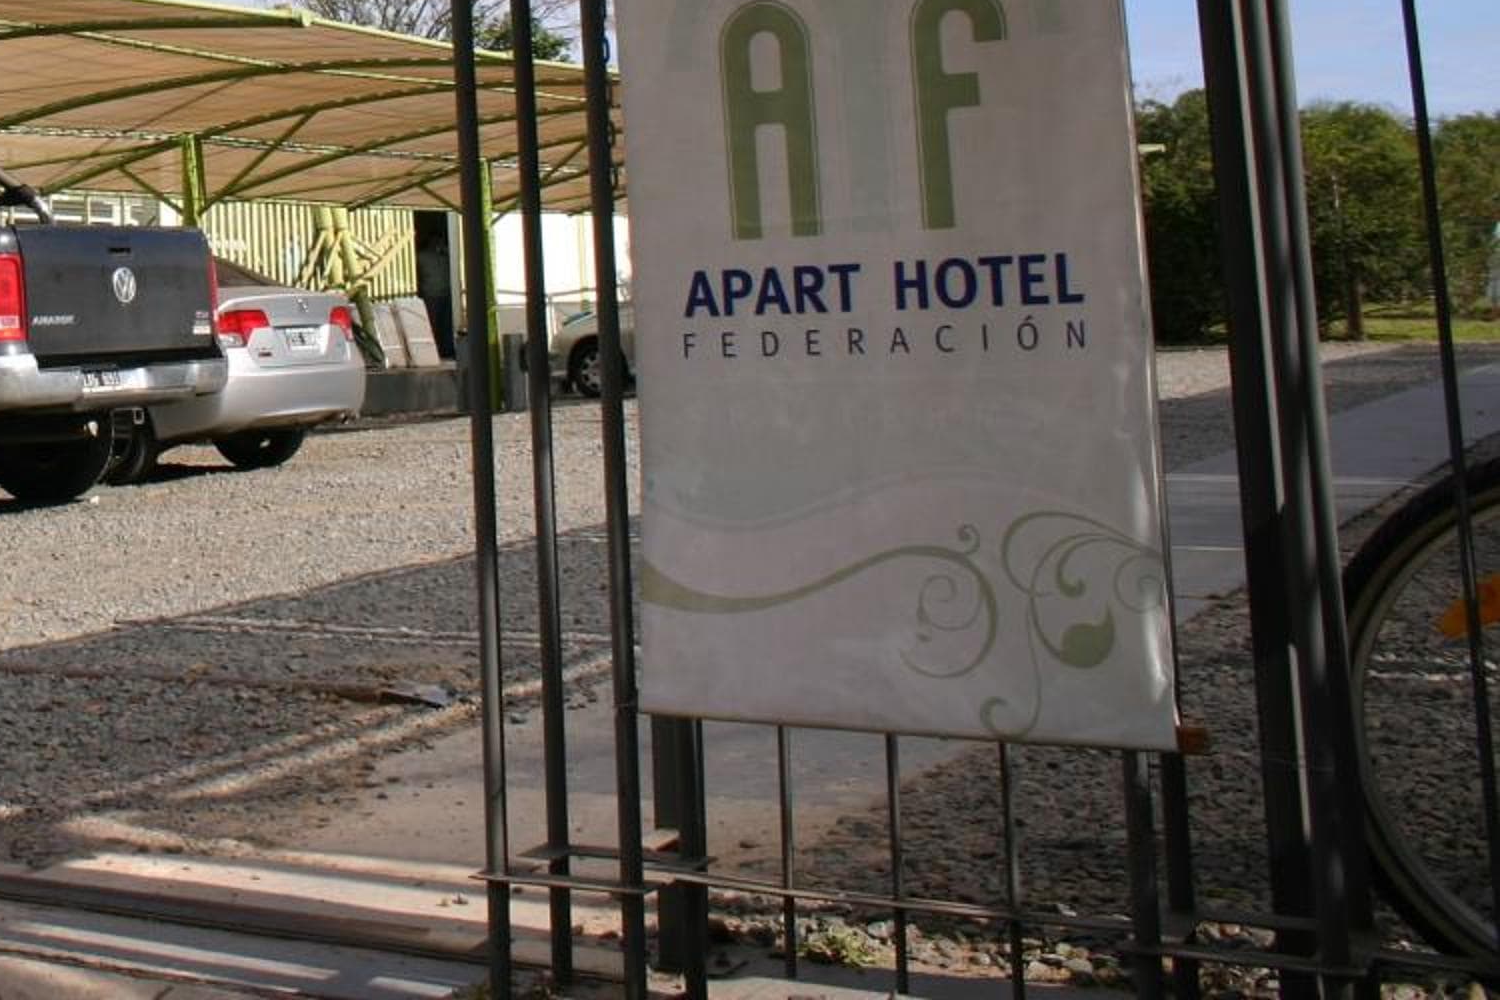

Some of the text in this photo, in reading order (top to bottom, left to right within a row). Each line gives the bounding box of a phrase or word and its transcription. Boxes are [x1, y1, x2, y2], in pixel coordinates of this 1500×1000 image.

[684, 252, 1086, 317] APART HOTEL
[683, 316, 1086, 358] FEDERACIÓN
